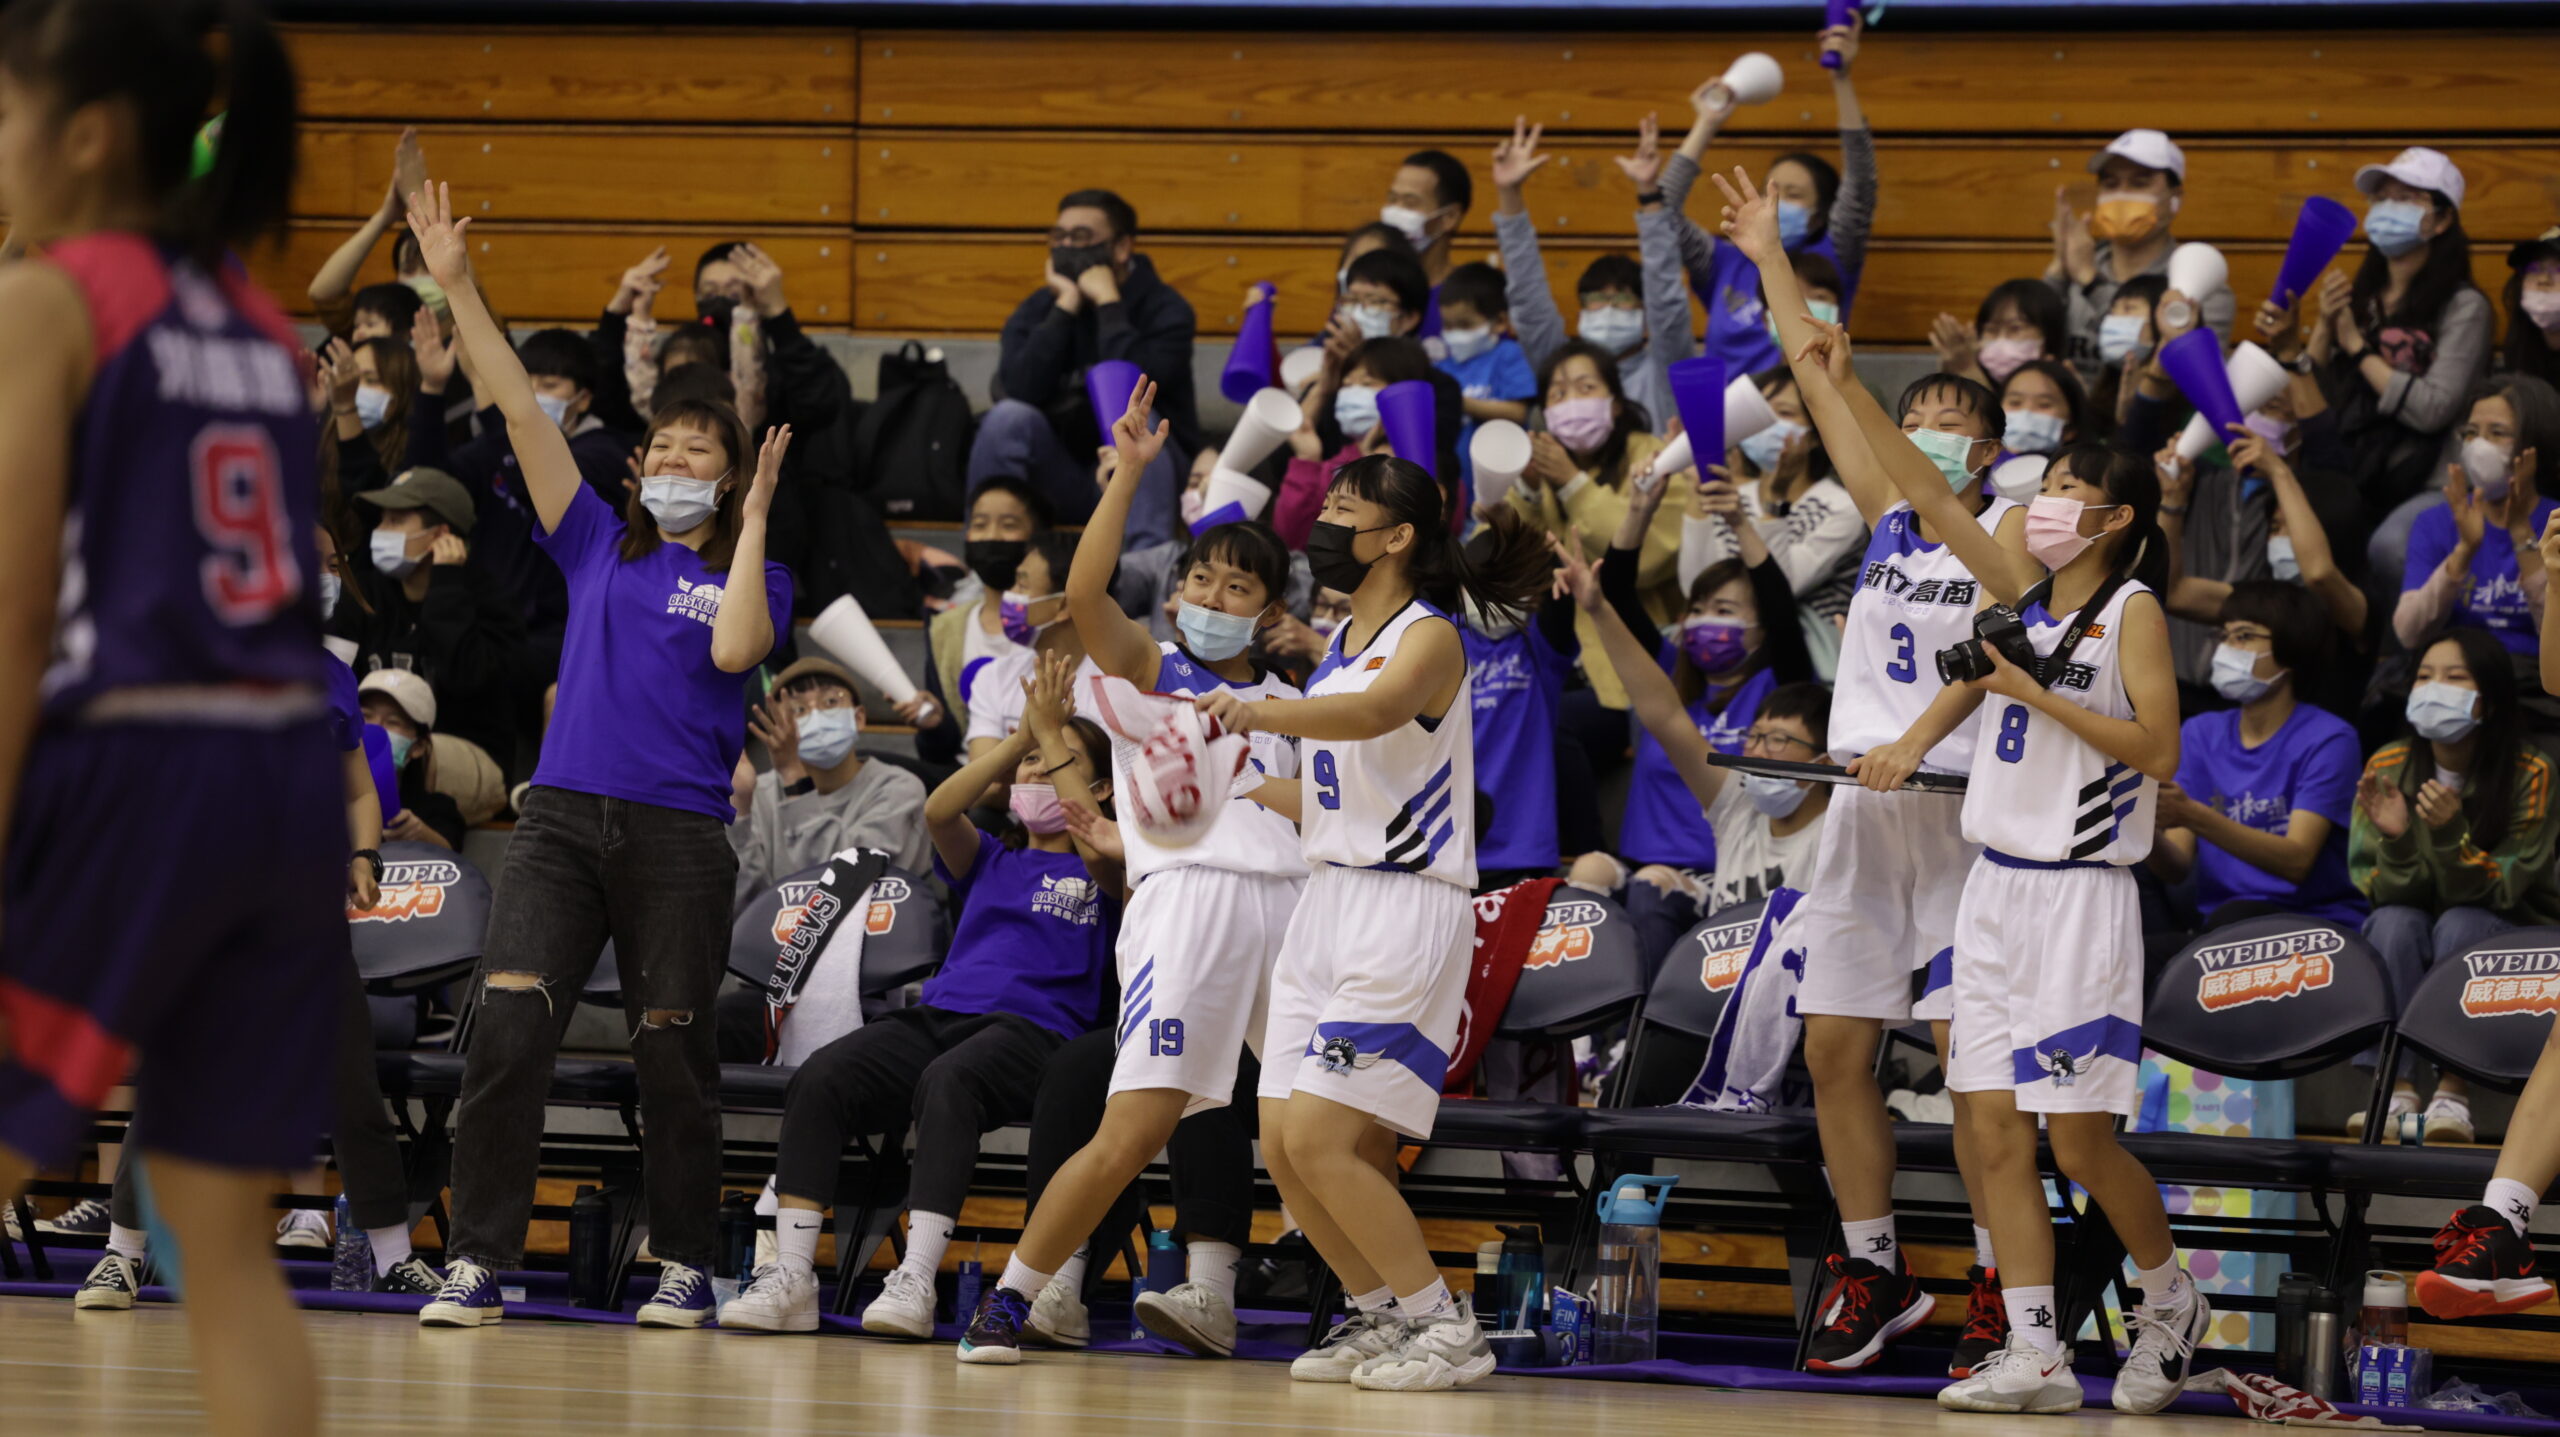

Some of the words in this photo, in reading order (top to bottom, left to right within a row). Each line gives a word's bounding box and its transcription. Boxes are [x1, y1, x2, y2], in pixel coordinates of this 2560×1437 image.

[191, 422, 301, 627] 9
[1862, 561, 1982, 608] 新竹高商
[668, 592, 719, 617] BASKET
[1886, 622, 1917, 684] 3
[2064, 627, 2081, 648] EOS
[1996, 704, 2029, 763] 8
[1313, 750, 1340, 810] 9
[380, 864, 449, 883] IDER
[2203, 932, 2330, 969] WEIDER
[2473, 953, 2560, 974] WEID
[1149, 1018, 1185, 1056] 19
[1555, 1308, 1577, 1323] FIN
